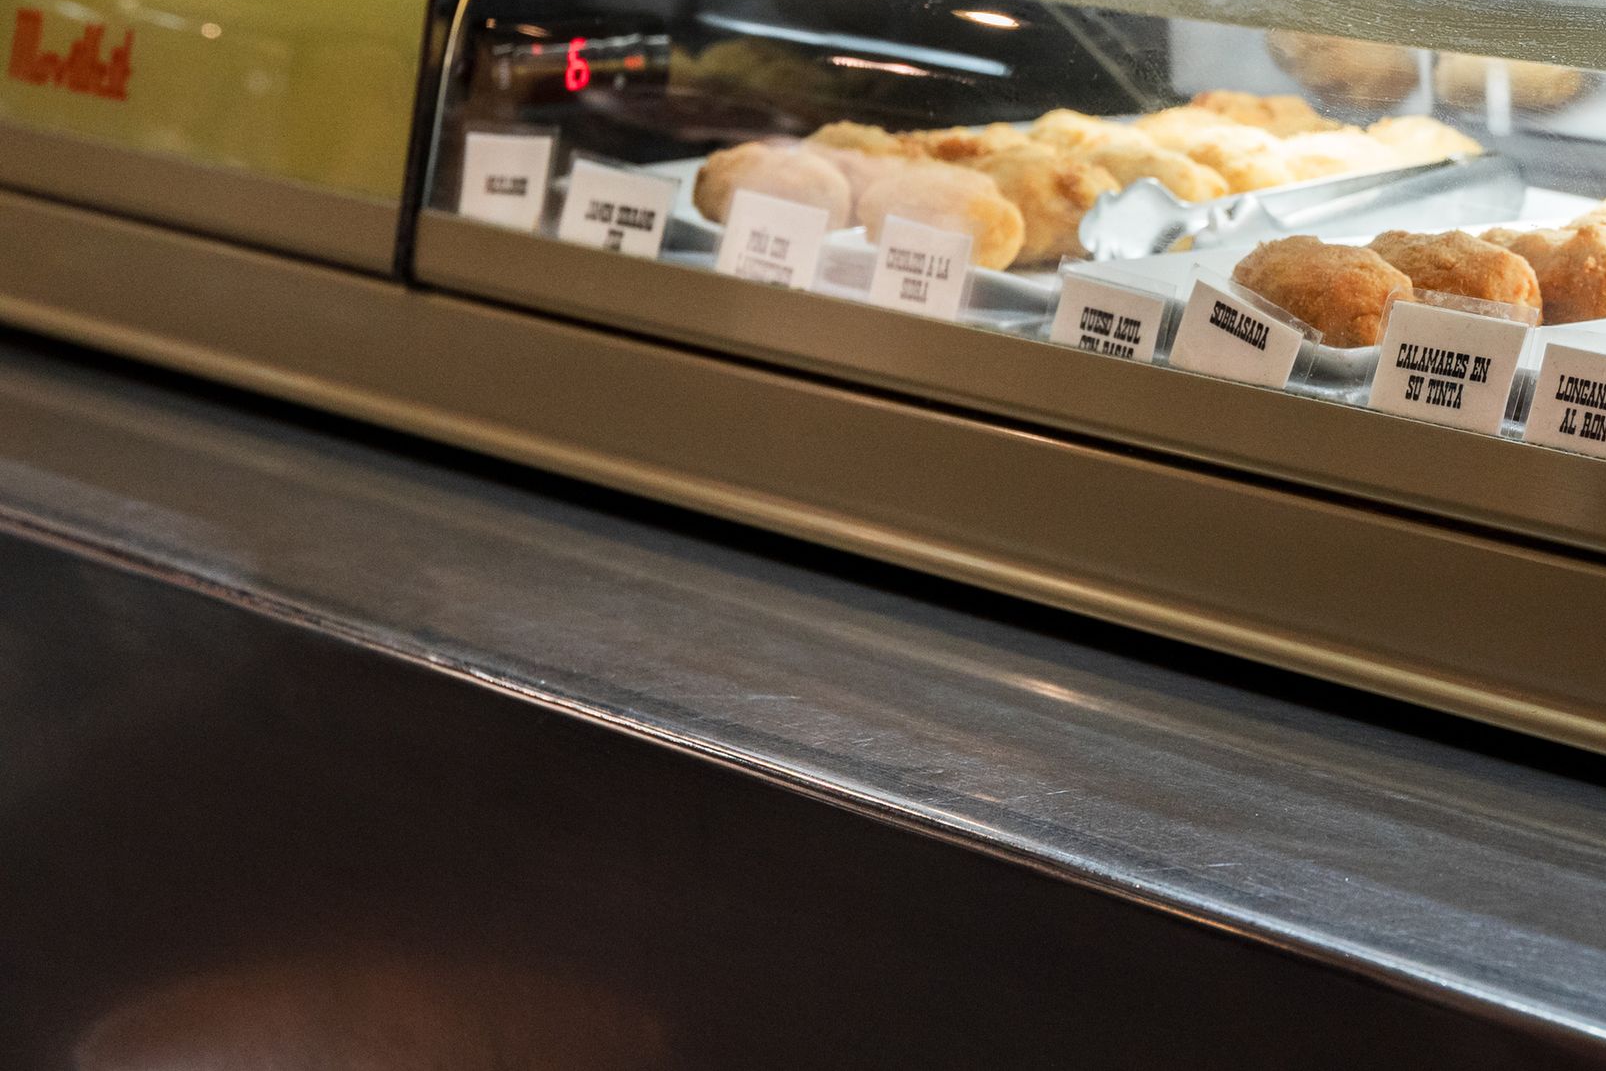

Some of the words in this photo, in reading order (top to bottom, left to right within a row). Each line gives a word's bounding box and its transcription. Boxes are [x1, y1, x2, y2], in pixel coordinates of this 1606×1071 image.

[1079, 306, 1114, 337] QUESO
[1113, 315, 1141, 345] AZUL
[1208, 300, 1270, 351] SOBRASADA
[1396, 342, 1470, 380] CALAMARES
[1469, 356, 1492, 383] EN
[1404, 375, 1423, 401] SU
[1426, 378, 1464, 409] TINTA
[1558, 408, 1578, 435] AL
